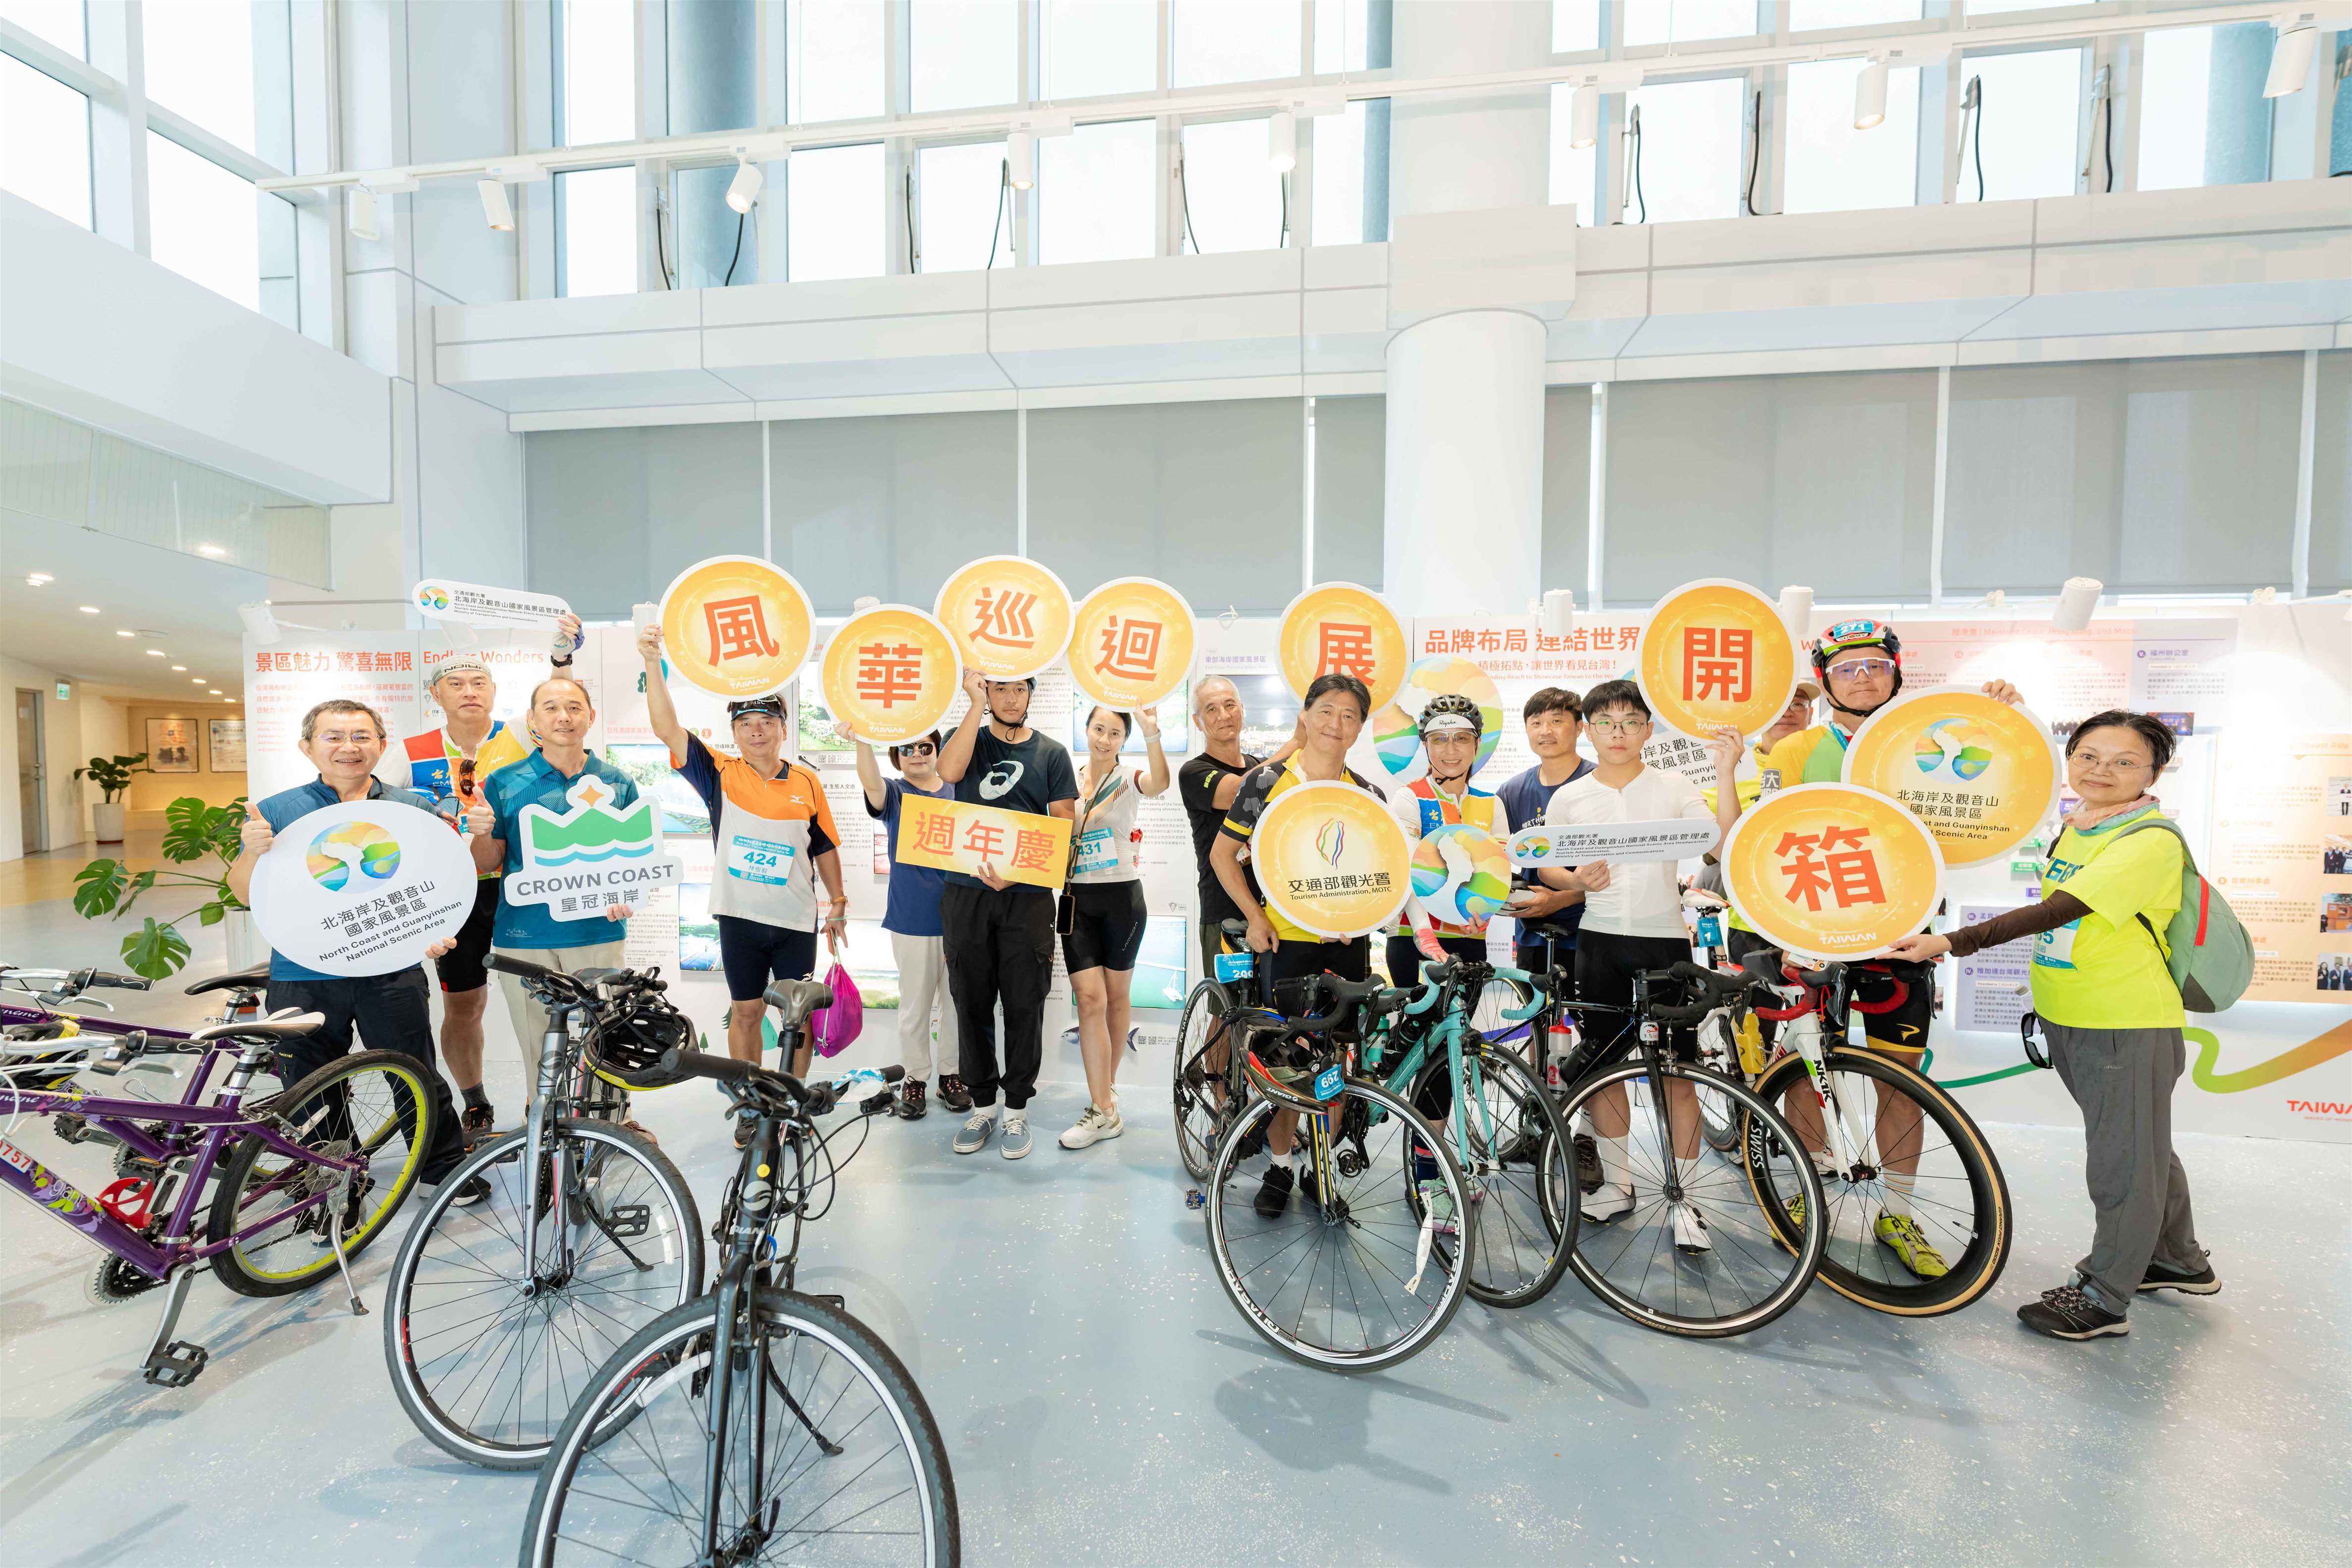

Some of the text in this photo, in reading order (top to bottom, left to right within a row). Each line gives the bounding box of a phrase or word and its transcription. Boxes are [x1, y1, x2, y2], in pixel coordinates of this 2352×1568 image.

[454, 590, 485, 598] 交通部觀光署
[454, 596, 566, 615] 北海岸及觀音山國家風景區管理處
[968, 587, 1038, 649] 巡
[703, 595, 779, 666] 風
[1840, 623, 1865, 634] 271
[1095, 614, 1162, 682] 迴
[1425, 626, 1640, 654] 品牌布局 連結世界
[255, 651, 412, 672] 景區魅力 驚喜無限
[481, 650, 544, 663] Wonders
[1312, 622, 1376, 688] 展
[980, 660, 1015, 670] TAIWAN
[1478, 659, 1617, 671] 積極拓點，讓世界看見台灣！
[1683, 627, 1753, 703] 開
[730, 677, 770, 690] TAIWAN
[856, 643, 923, 709] 華
[1103, 690, 1137, 701] TAIWAN
[1701, 774, 1717, 783] Are
[1897, 789, 1999, 807] 北海岸及觀音山
[1910, 804, 1982, 819] 國家風景區
[1936, 830, 1964, 838] Scenic
[1952, 822, 2010, 832] Guanyinshan
[913, 811, 1055, 872] 週年慶
[1077, 842, 1101, 856] 431
[1557, 832, 1710, 848] 北海岸及觀音山國家風景區管理處
[744, 851, 777, 867] 424
[1774, 825, 1887, 912] 箱
[517, 864, 674, 896] CROWN COAST
[1288, 872, 1391, 893] 交通部觀光署
[561, 889, 640, 913] 皇冠海岸
[1319, 889, 1371, 898] Administration,
[321, 880, 435, 931] 北海岸及觀音山
[345, 898, 427, 938] 國家風景區
[319, 901, 462, 961] North Coast and Guanyinshan
[346, 918, 446, 962] National Scenic Area
[1704, 931, 1711, 942] 1
[1819, 932, 1877, 945] TAIWAN
[1321, 1070, 1339, 1088] 299
[1266, 1086, 1293, 1099] GIANT
[1750, 1124, 1764, 1169] SWISS
